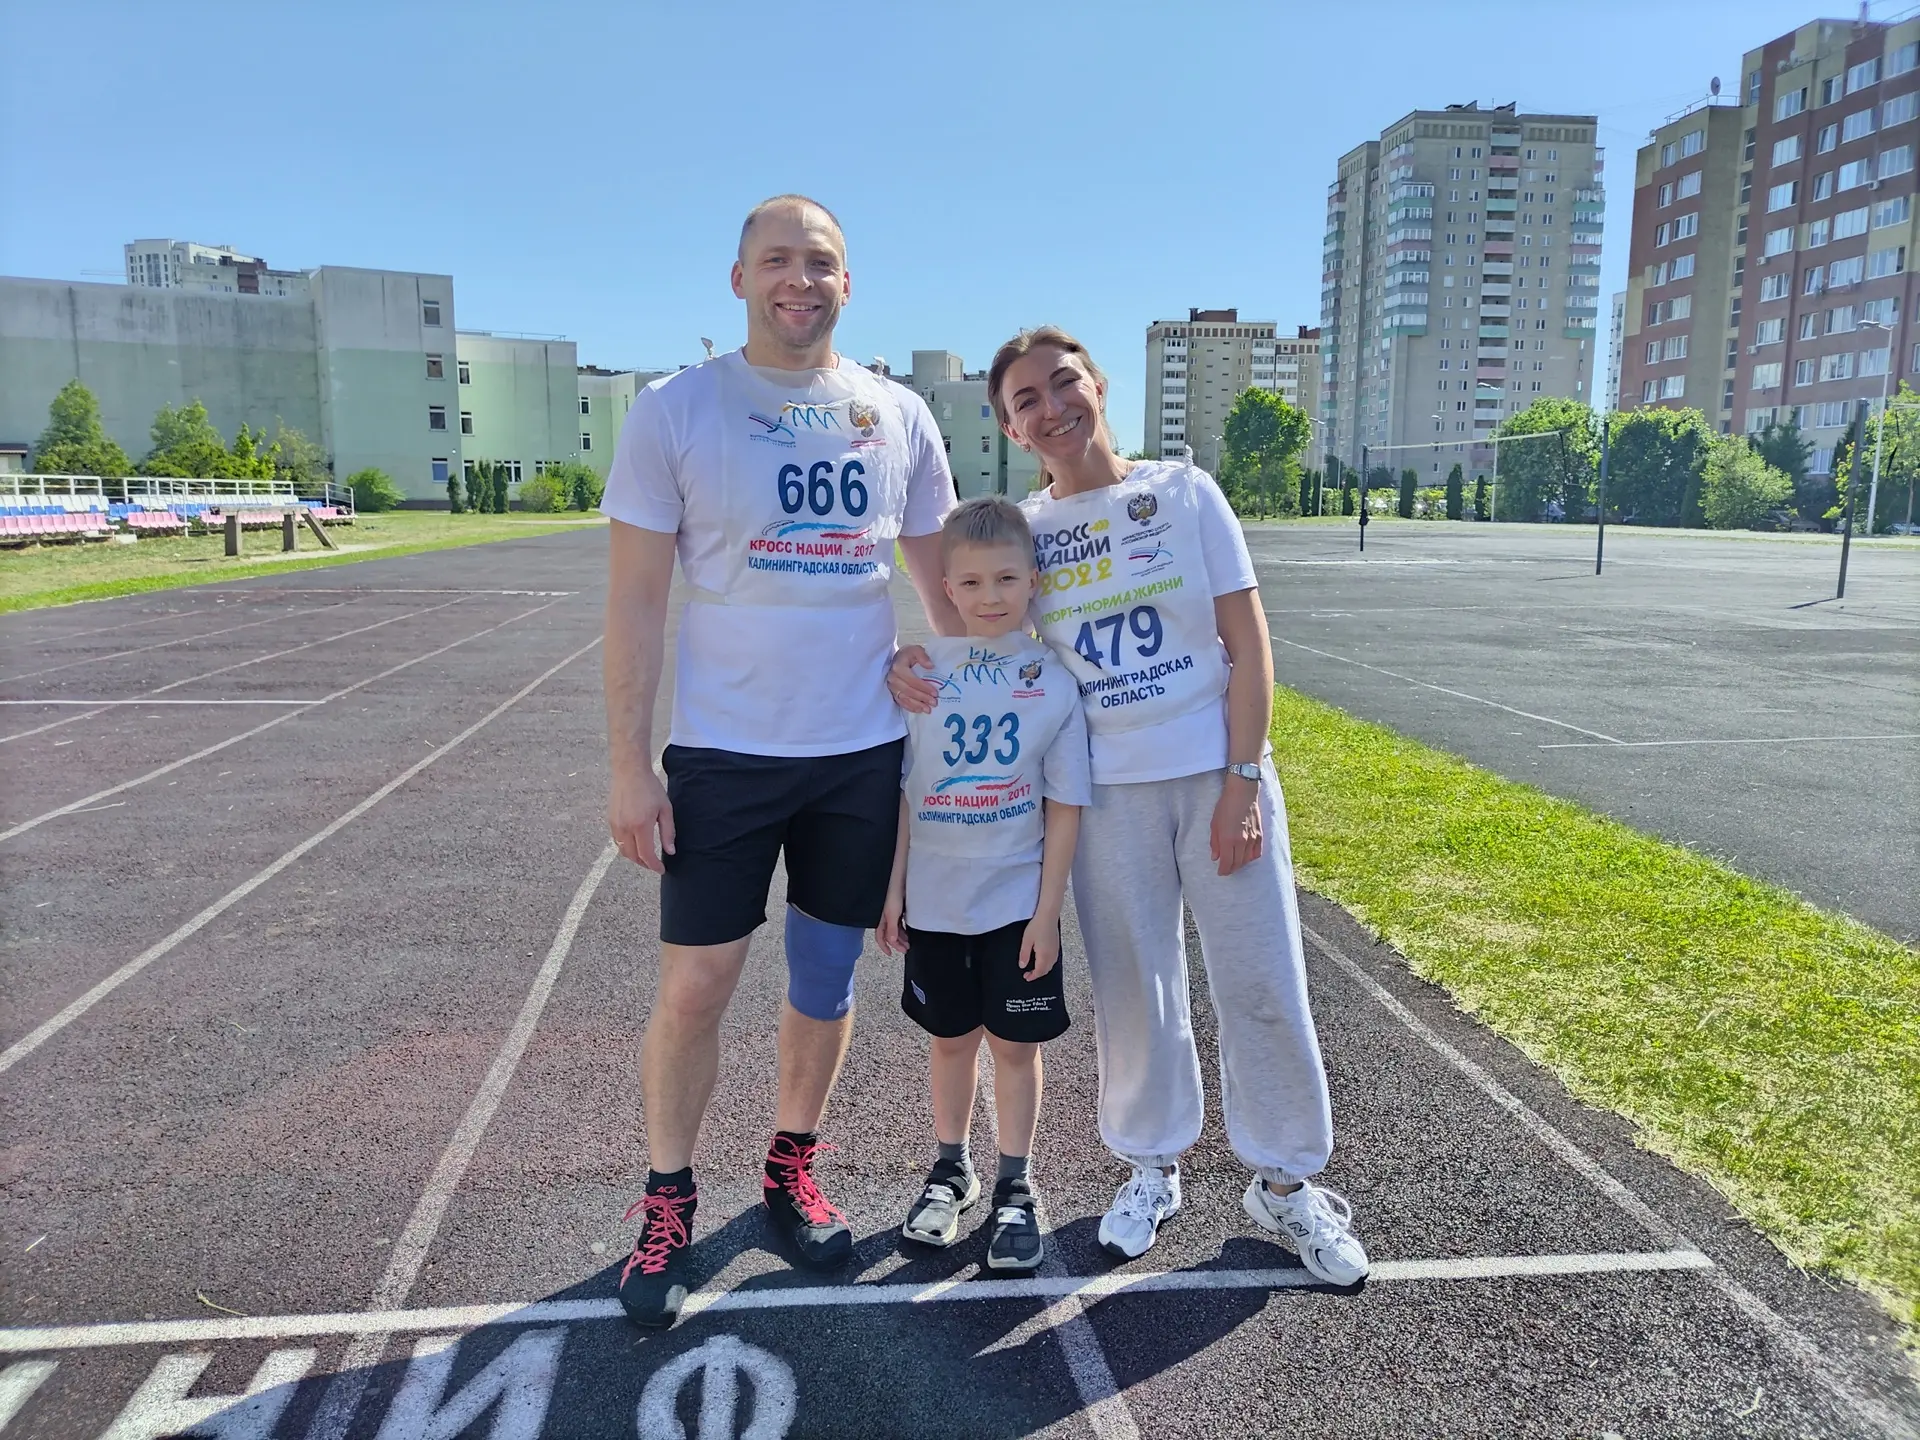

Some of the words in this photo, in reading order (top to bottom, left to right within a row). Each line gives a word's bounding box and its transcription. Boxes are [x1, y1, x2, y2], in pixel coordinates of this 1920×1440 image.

[778, 460, 868, 517] 666
[750, 539, 793, 553] КРОСС
[796, 543, 842, 557] НАЦИИ
[854, 544, 876, 557] 2017
[1033, 522, 1090, 553] КРОСС
[1036, 536, 1111, 572] НАЦИИ
[749, 556, 840, 575] КАЛИНИНГРАДСКАЯ
[841, 561, 879, 575] ОБЛАСТЬ
[1040, 557, 1112, 597] 2022
[1082, 591, 1132, 614] НОРМА
[1133, 575, 1184, 599] ЖИЗНИ
[1074, 605, 1164, 669] 479
[1101, 684, 1165, 709] ОБЛАСТЬ
[942, 712, 1020, 767] 333
[918, 810, 999, 826] КАЛИНИНГРАДСКАЯ
[1000, 800, 1036, 820] ОБЛАСТЬ
[955, 795, 999, 809] НАЦИИ
[1008, 784, 1031, 801] 2017
